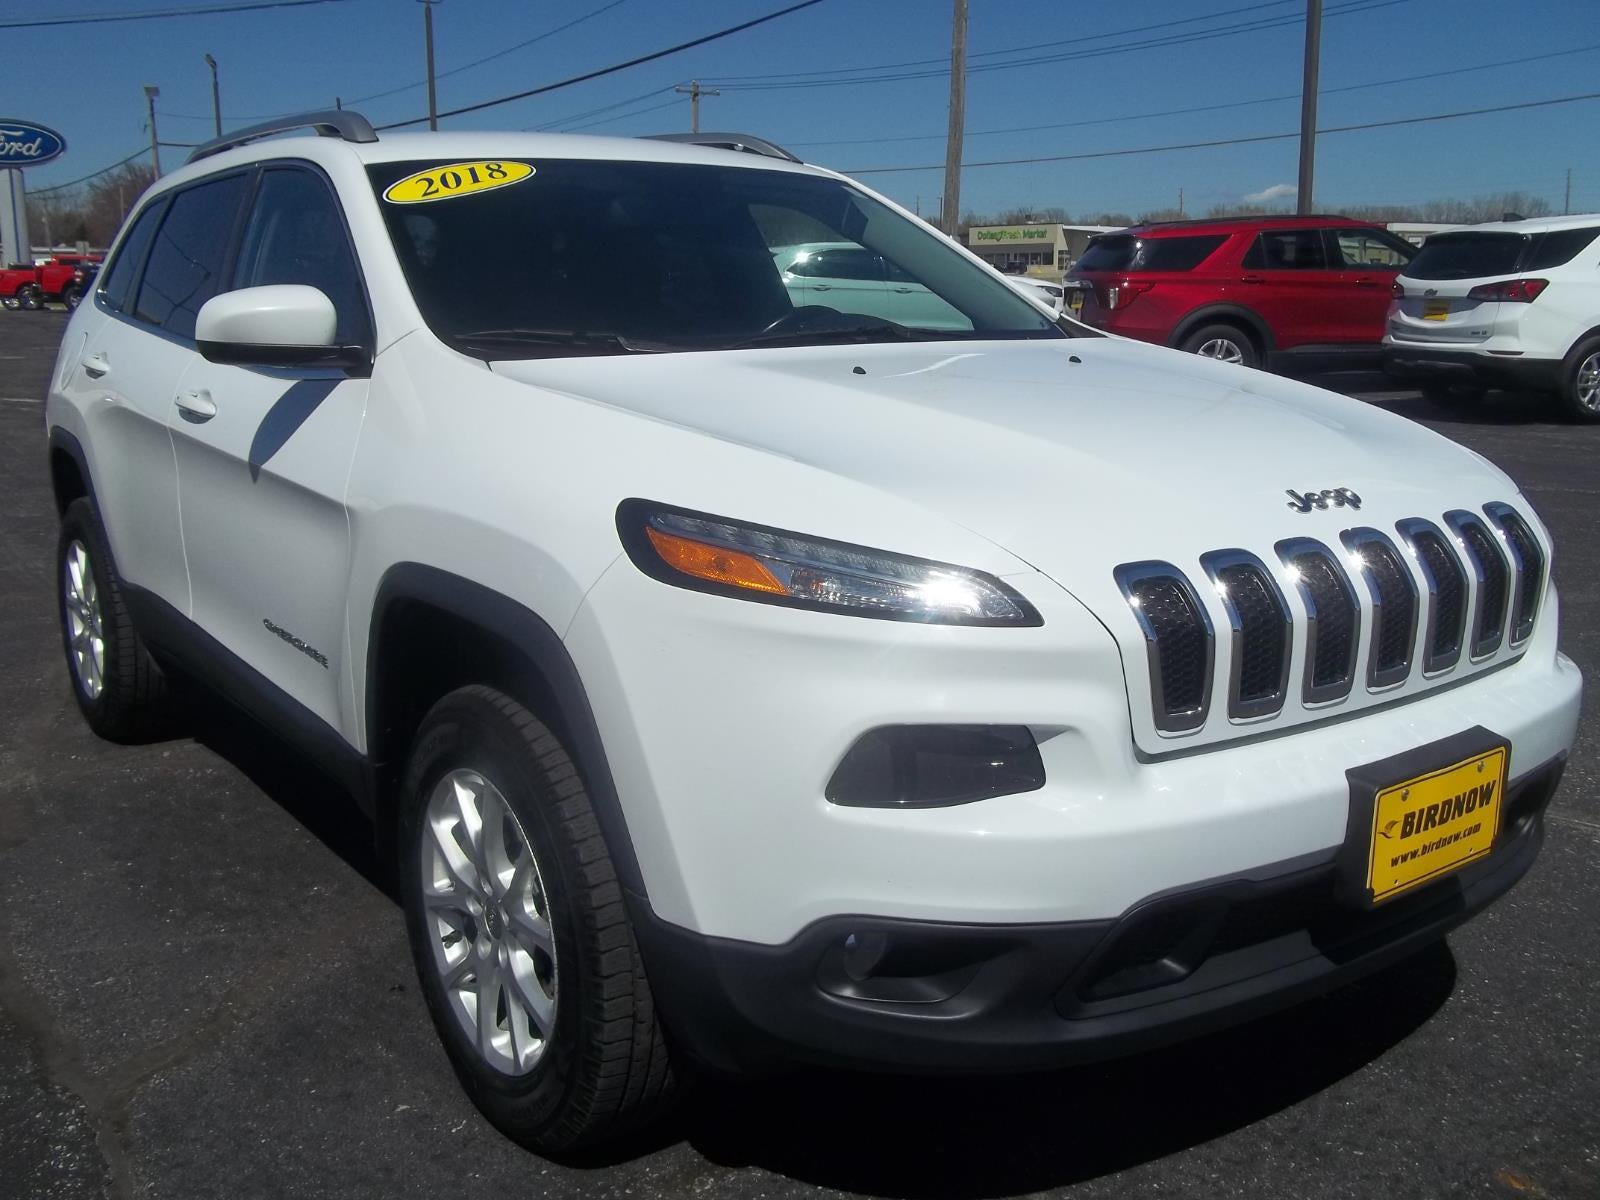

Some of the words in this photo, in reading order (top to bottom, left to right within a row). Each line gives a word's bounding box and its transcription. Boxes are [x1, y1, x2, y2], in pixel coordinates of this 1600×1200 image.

[415, 163, 508, 197] 2018
[1285, 487, 1361, 513] Jeep
[1400, 780, 1497, 839] BIRDNOW
[1390, 822, 1482, 867] www.birdnow.com
